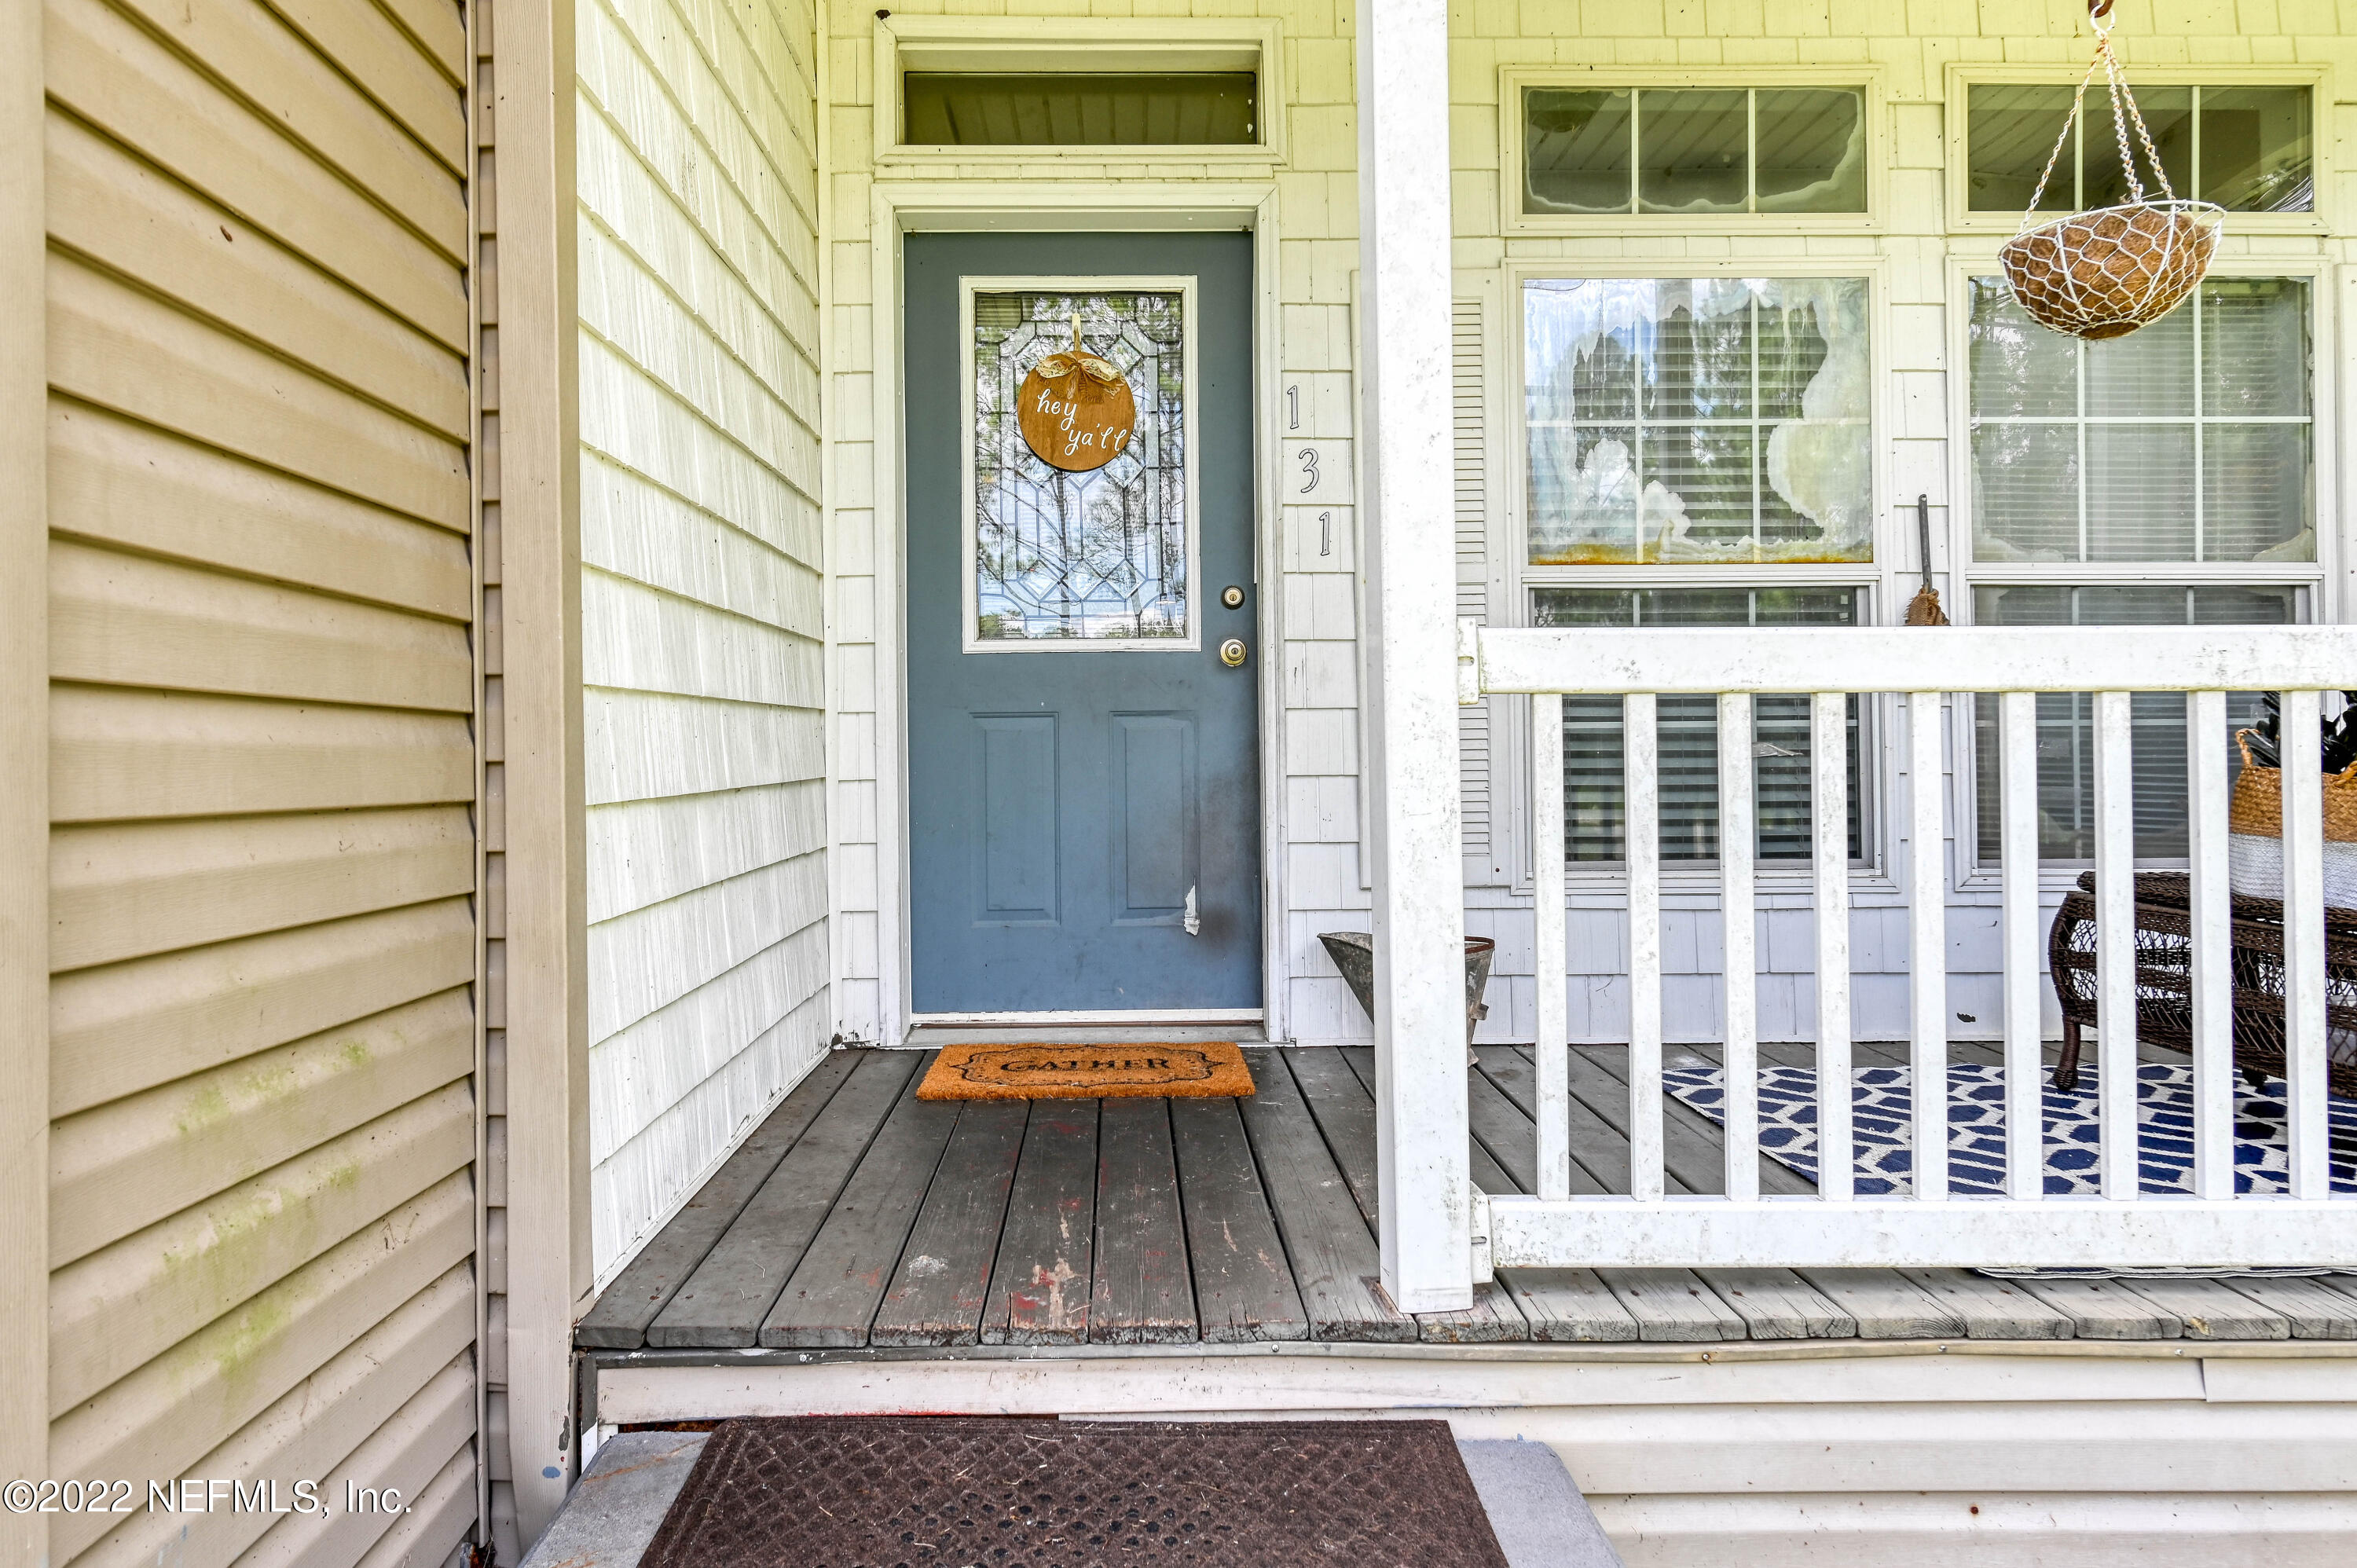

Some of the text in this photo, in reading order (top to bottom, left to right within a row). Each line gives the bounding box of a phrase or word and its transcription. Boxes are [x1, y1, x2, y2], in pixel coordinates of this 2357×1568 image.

[1037, 388, 1077, 431] hey
[1064, 423, 1127, 456] ya'll
[1000, 1057, 1171, 1072] GATHER
